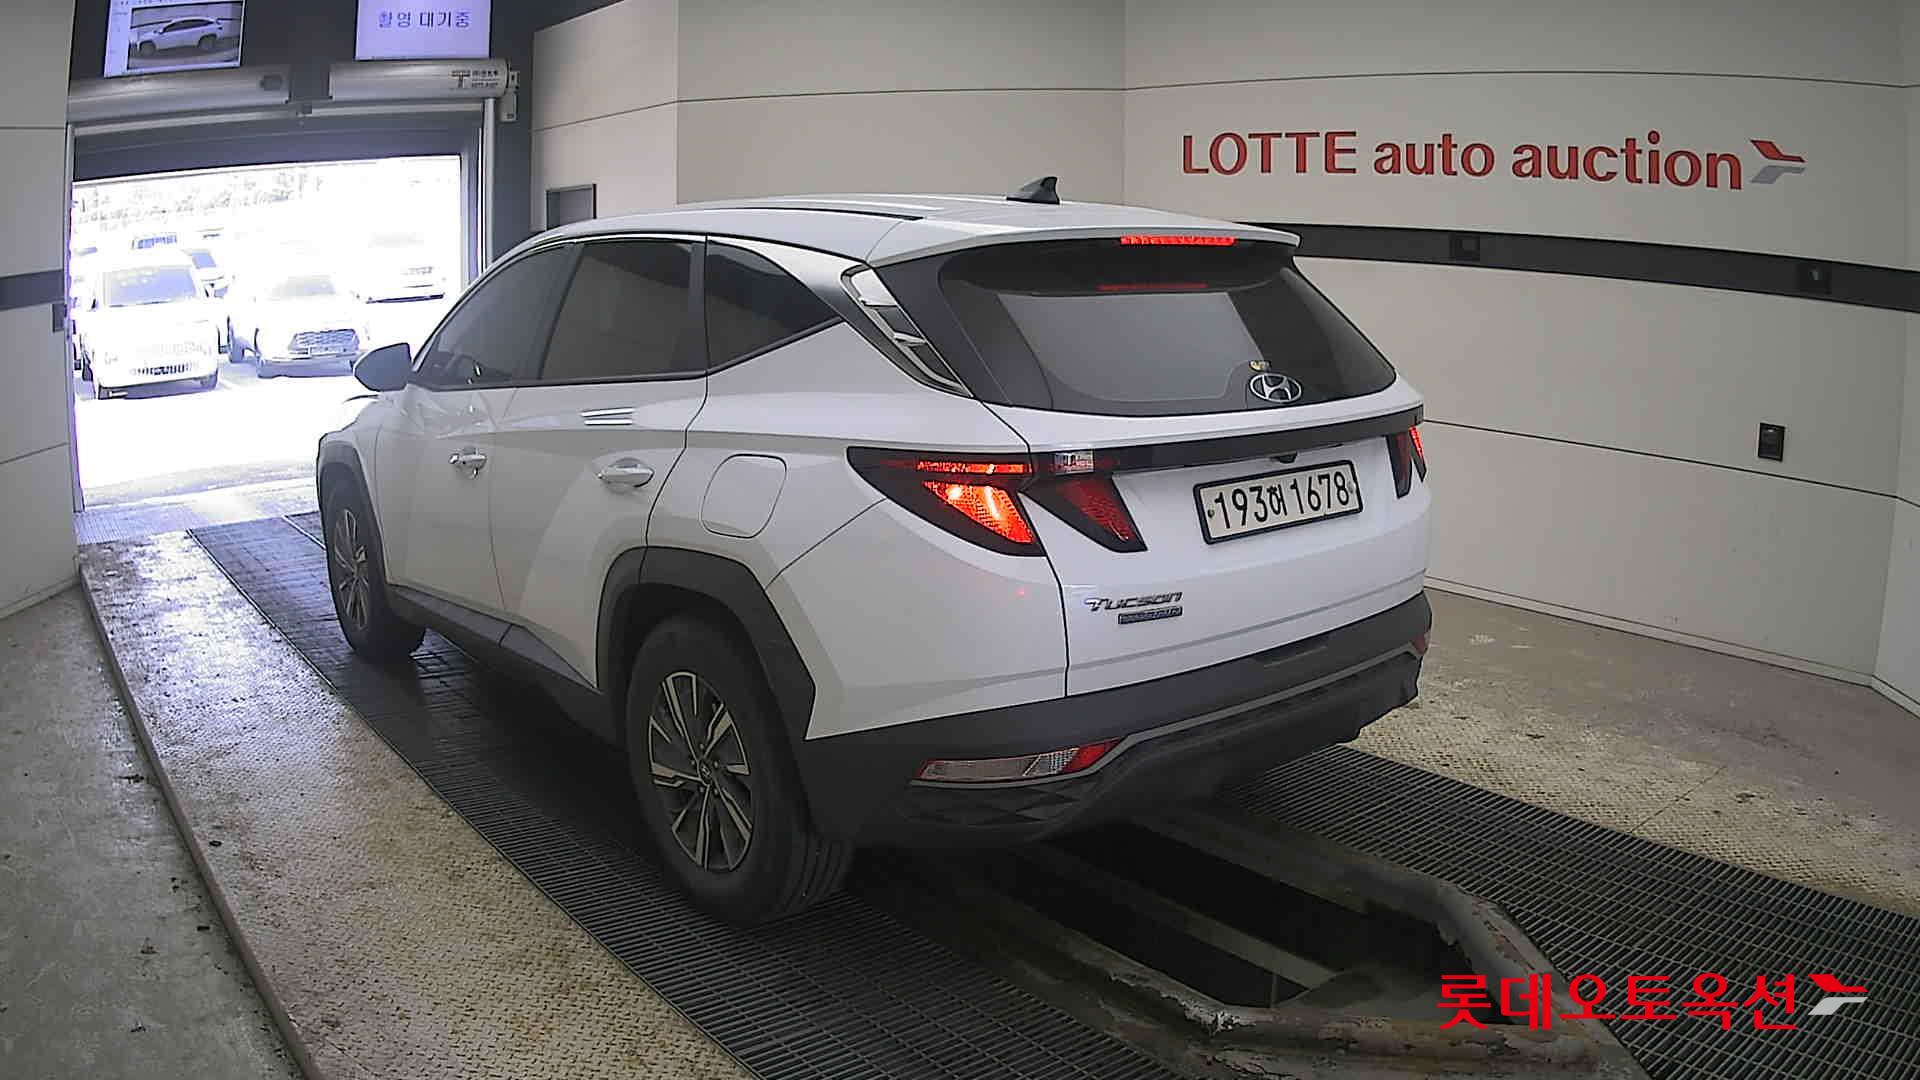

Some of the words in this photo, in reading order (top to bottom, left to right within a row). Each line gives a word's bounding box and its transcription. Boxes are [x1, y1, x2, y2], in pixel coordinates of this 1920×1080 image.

[419, 10, 471, 28] 대기중
[1183, 131, 1358, 175] LOTTE
[1373, 132, 1496, 177] auto
[1511, 130, 1744, 190] auction
[1214, 484, 1288, 529] 193허
[1290, 471, 1350, 514] 1678
